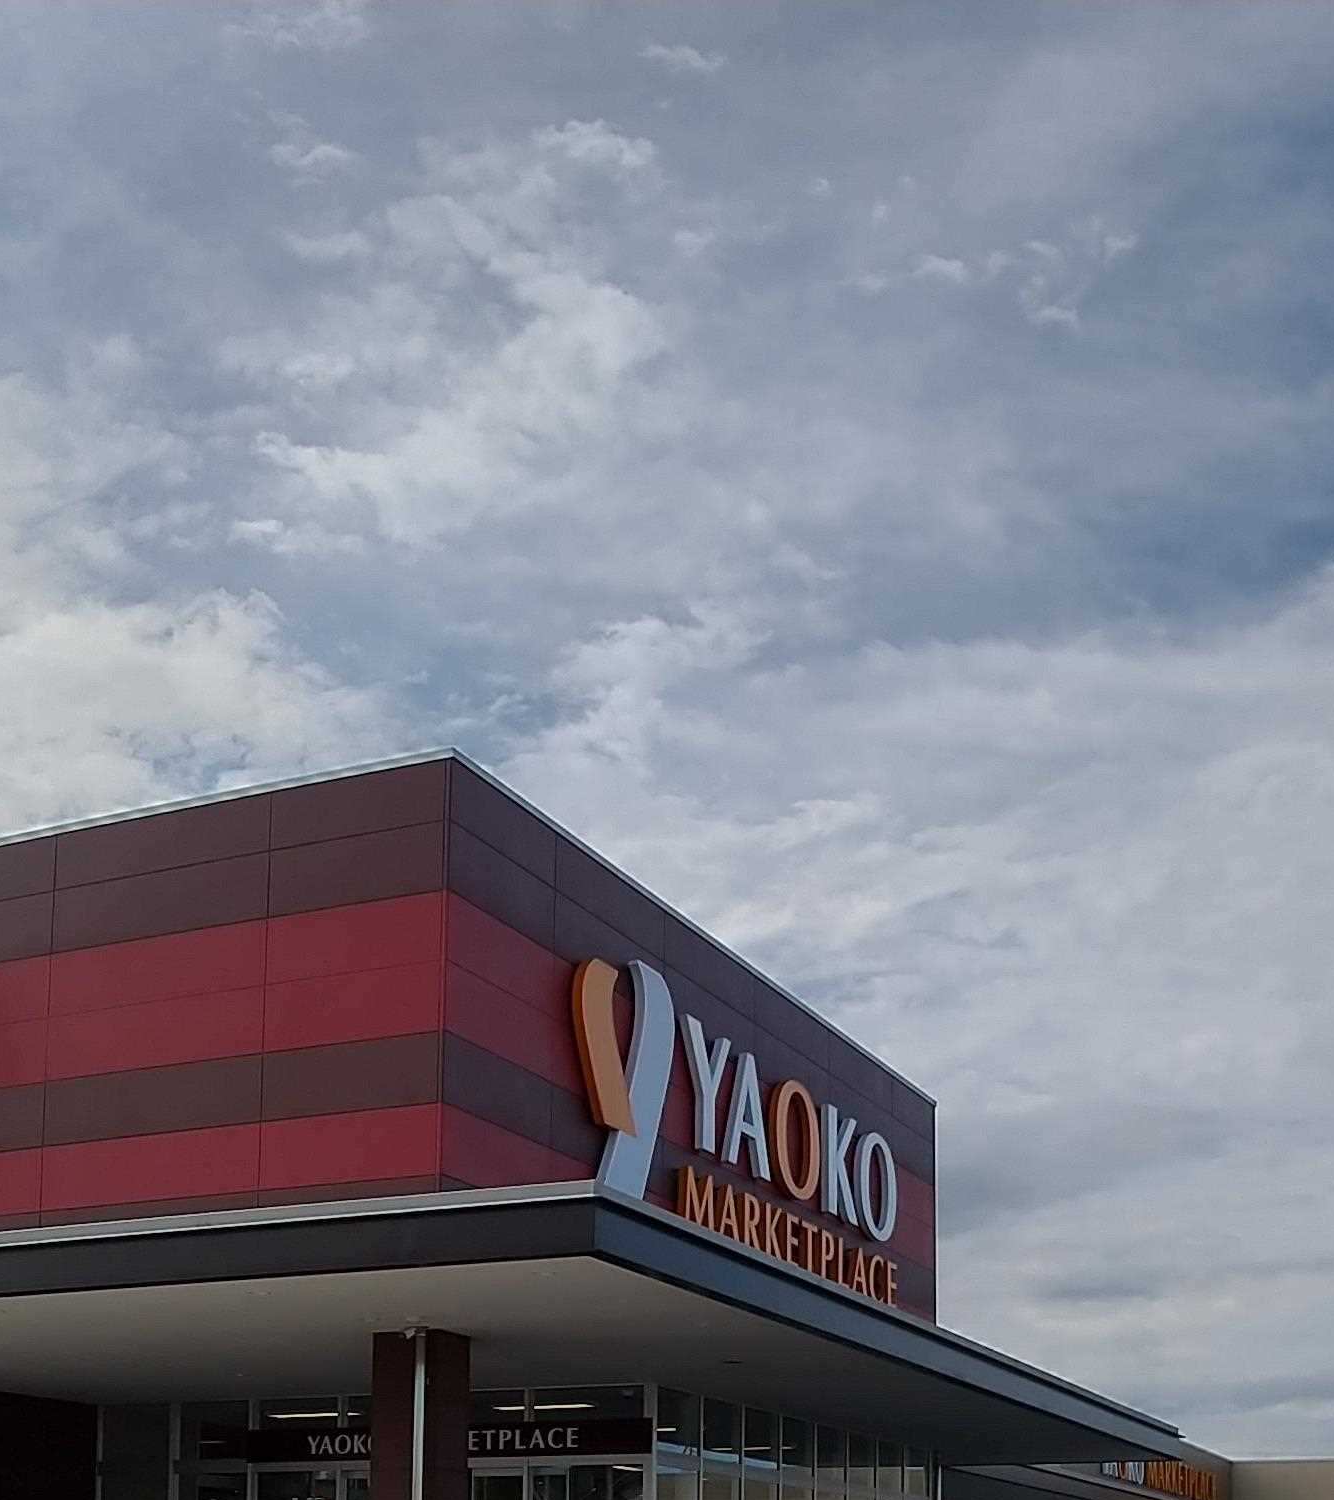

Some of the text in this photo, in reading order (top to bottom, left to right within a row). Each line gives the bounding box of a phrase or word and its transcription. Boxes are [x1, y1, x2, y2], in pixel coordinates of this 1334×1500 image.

[679, 1013, 898, 1242] YAOKO
[677, 1165, 899, 1307] MARKETPLACE
[307, 1427, 580, 1456] YAOK ETPLACE
